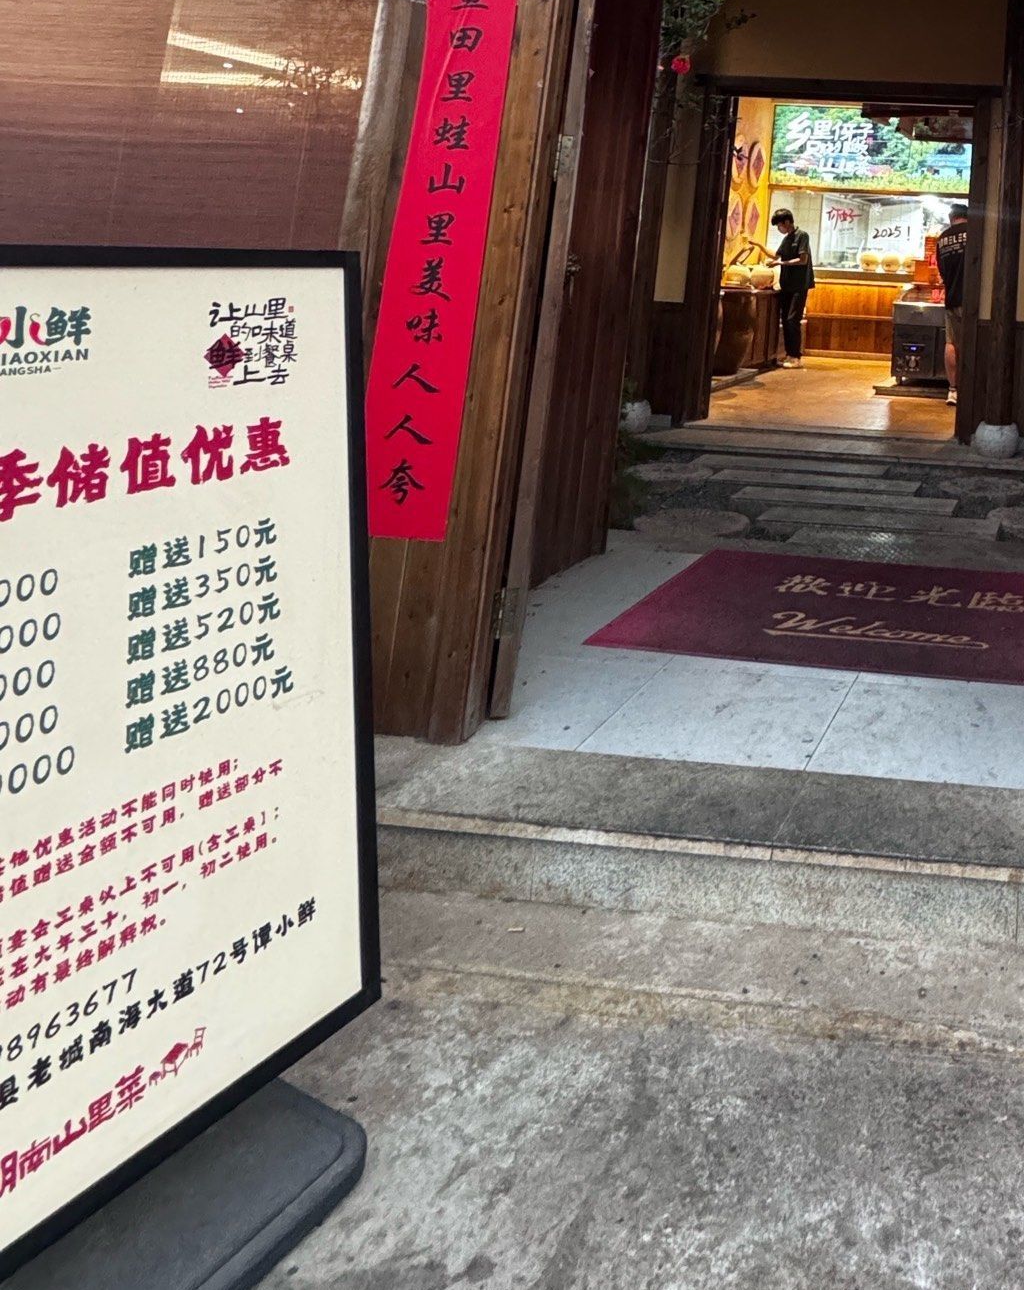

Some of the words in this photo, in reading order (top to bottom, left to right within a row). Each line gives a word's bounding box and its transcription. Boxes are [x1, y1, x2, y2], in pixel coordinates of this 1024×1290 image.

[0, 417, 290, 522] 季储值优惠
[128, 517, 277, 578] 赠送150元
[127, 555, 278, 621] 赠送350元
[126, 592, 281, 664] 赠送520元
[772, 611, 972, 644] Welcome
[125, 632, 274, 708] 赠送880元
[0, 745, 75, 795] 000
[124, 665, 294, 754] 赠送2000元
[0, 968, 137, 1061] 8963677
